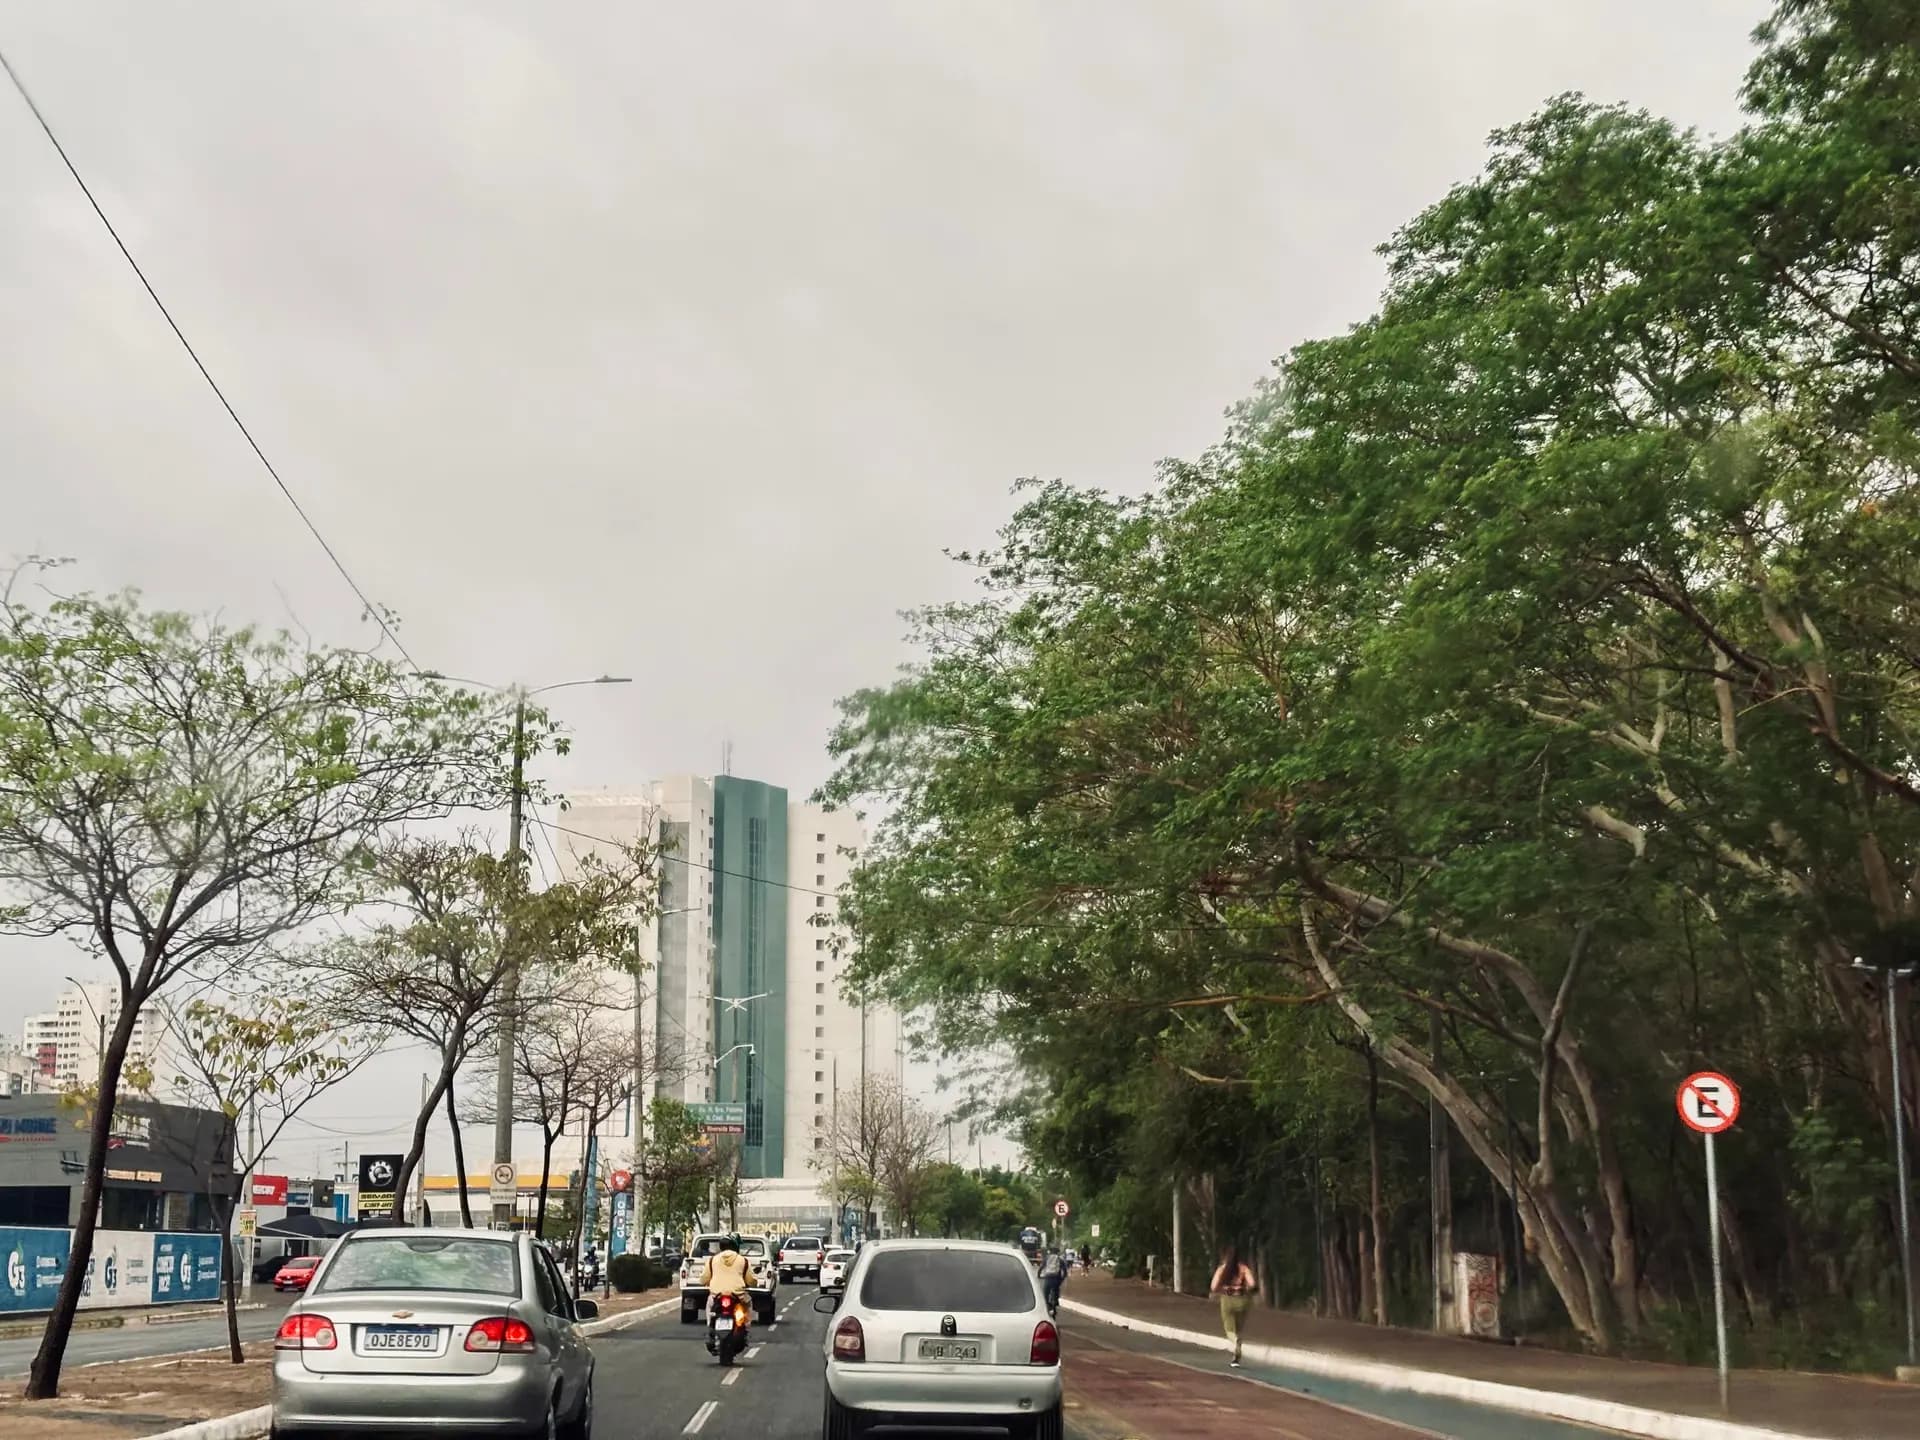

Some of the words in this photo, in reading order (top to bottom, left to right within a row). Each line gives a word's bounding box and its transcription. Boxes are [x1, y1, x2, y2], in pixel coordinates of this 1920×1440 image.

[1696, 1086, 1720, 1118] E
[737, 1221, 799, 1234] MEDICINA
[371, 1334, 431, 1348] OJE8E90
